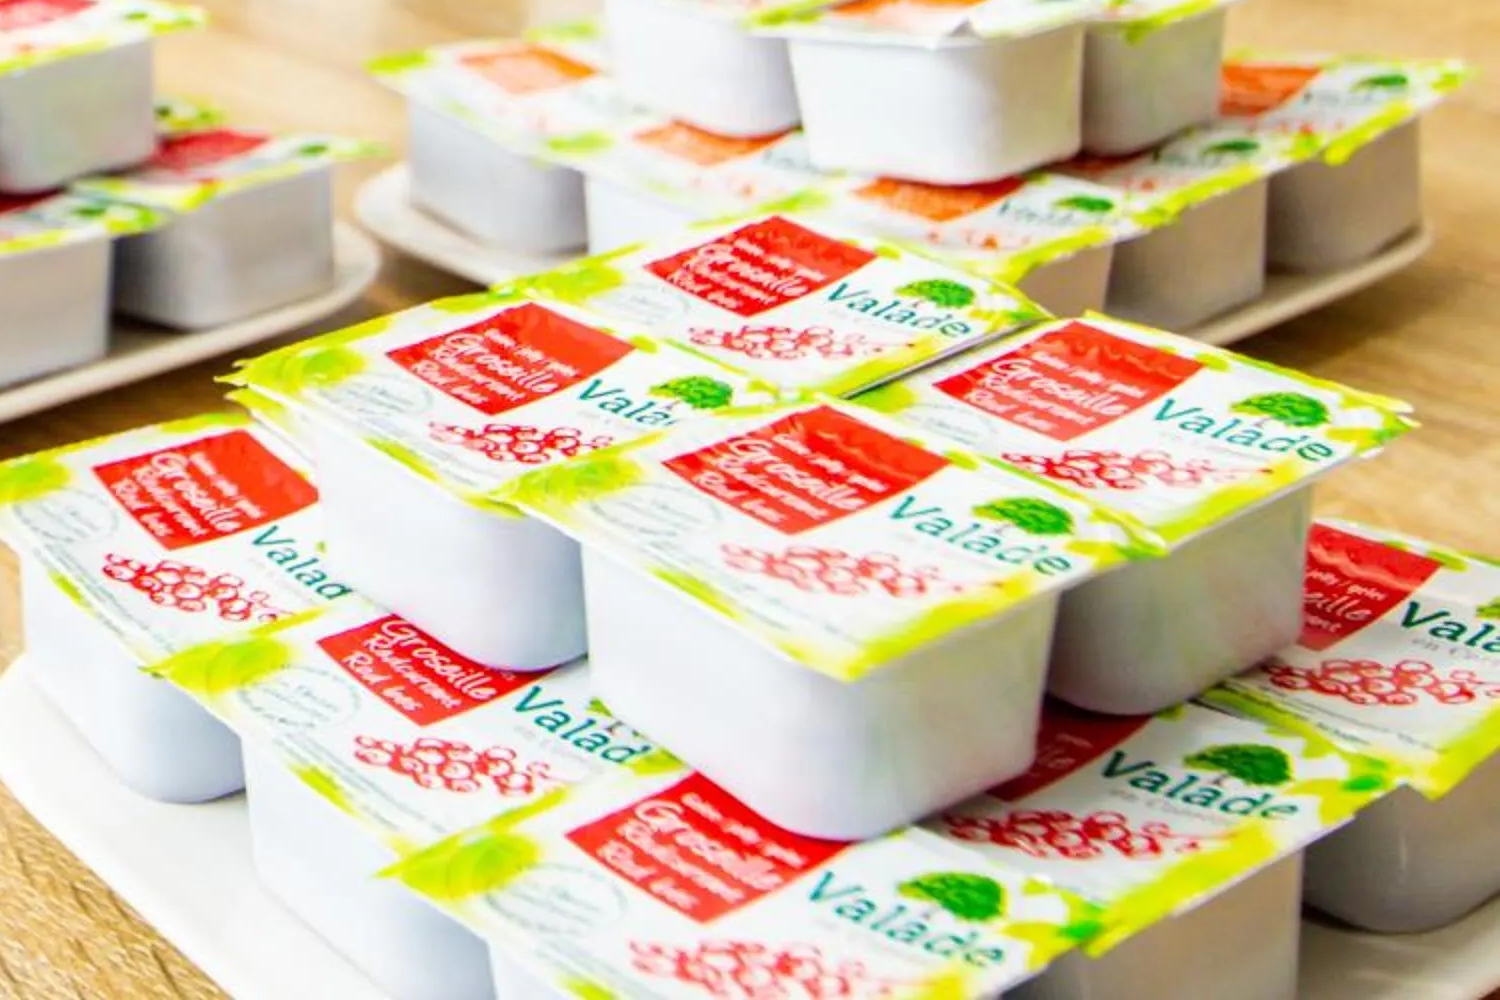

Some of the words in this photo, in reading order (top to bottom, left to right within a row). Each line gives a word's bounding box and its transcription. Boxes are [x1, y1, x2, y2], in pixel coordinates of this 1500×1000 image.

[825, 282, 973, 338] Valade
[578, 378, 680, 426] Vala
[1151, 397, 1336, 463] Valade
[251, 524, 358, 600] Valad
[889, 494, 1073, 576] Valade
[380, 620, 499, 700] Groseille
[513, 685, 656, 765] Valad
[1101, 749, 1299, 818] Valade
[808, 869, 1005, 969] Valade
